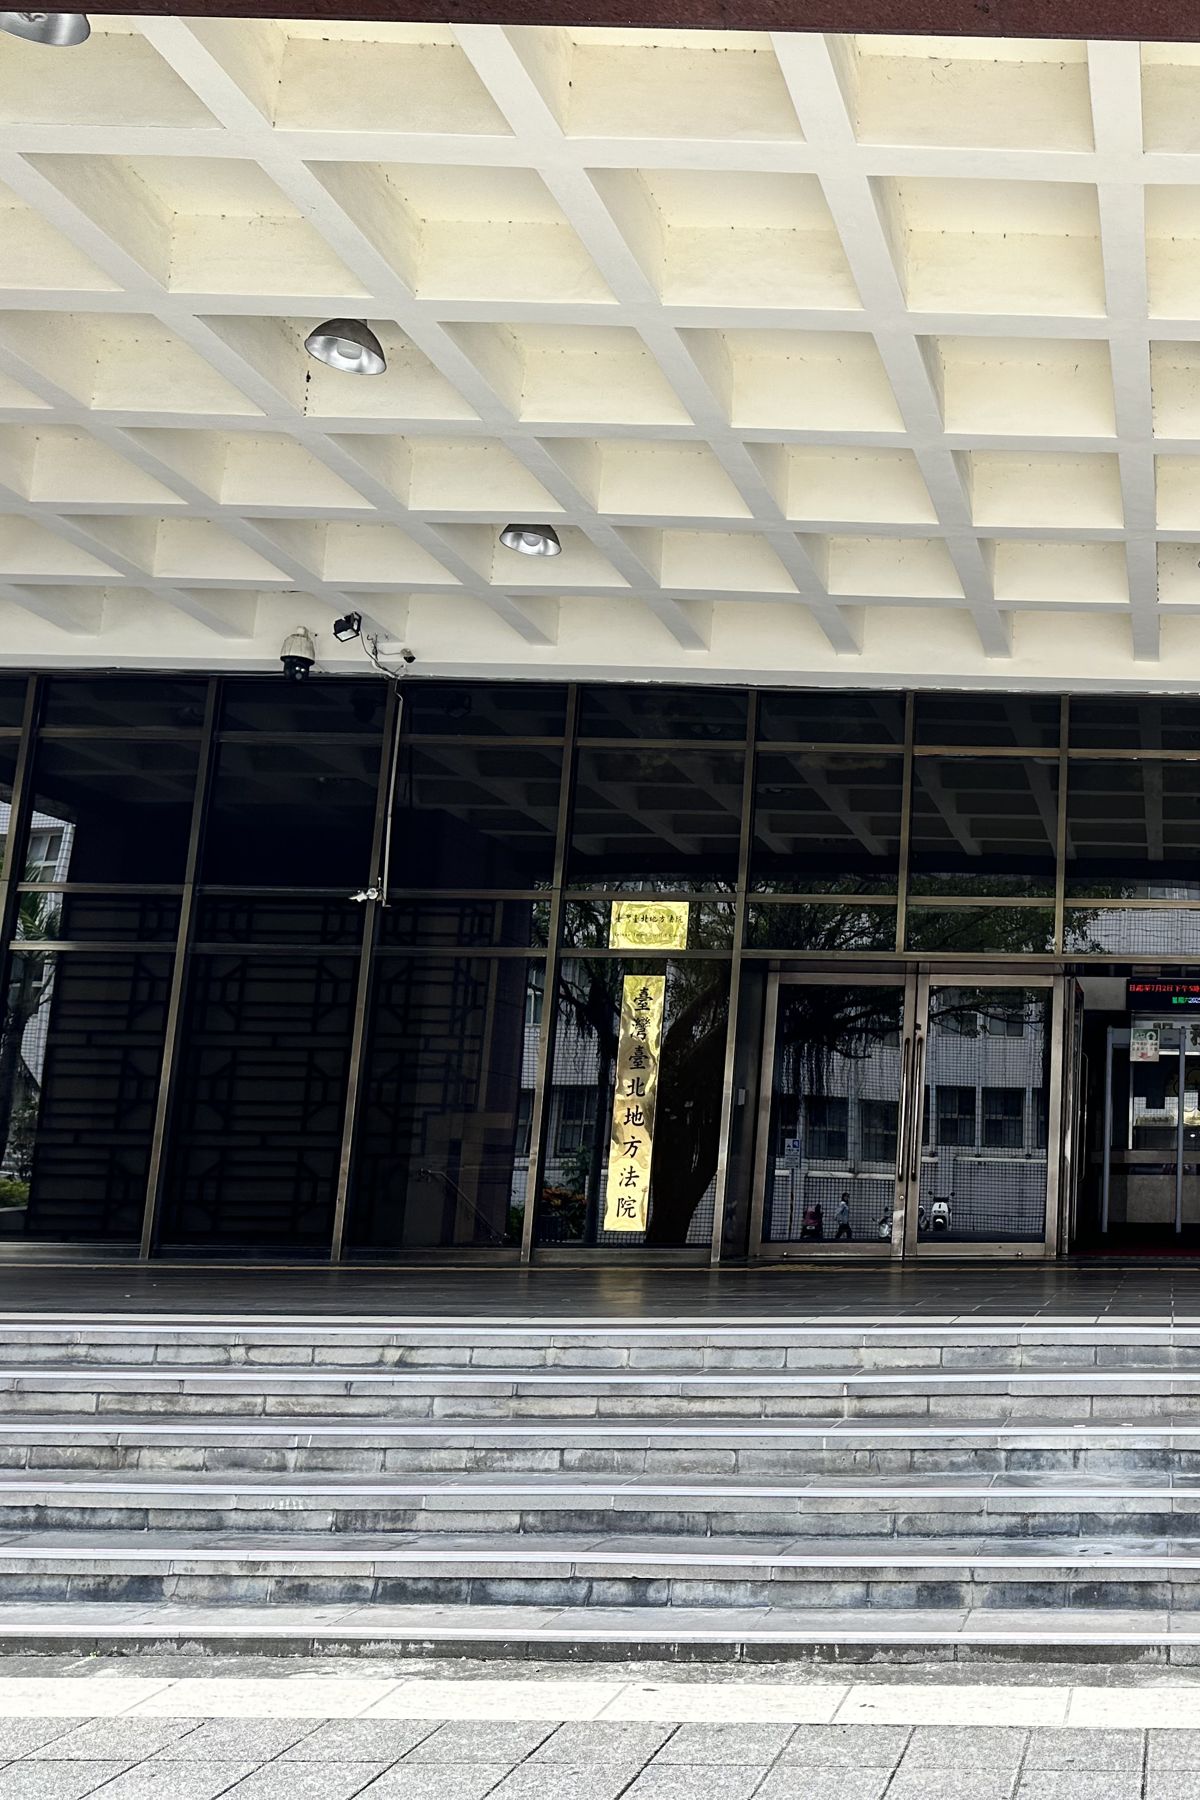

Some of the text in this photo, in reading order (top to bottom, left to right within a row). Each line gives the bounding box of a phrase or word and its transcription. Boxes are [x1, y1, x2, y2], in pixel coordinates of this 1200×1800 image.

[616, 986, 653, 1219] 臺灣臺北地方法院
